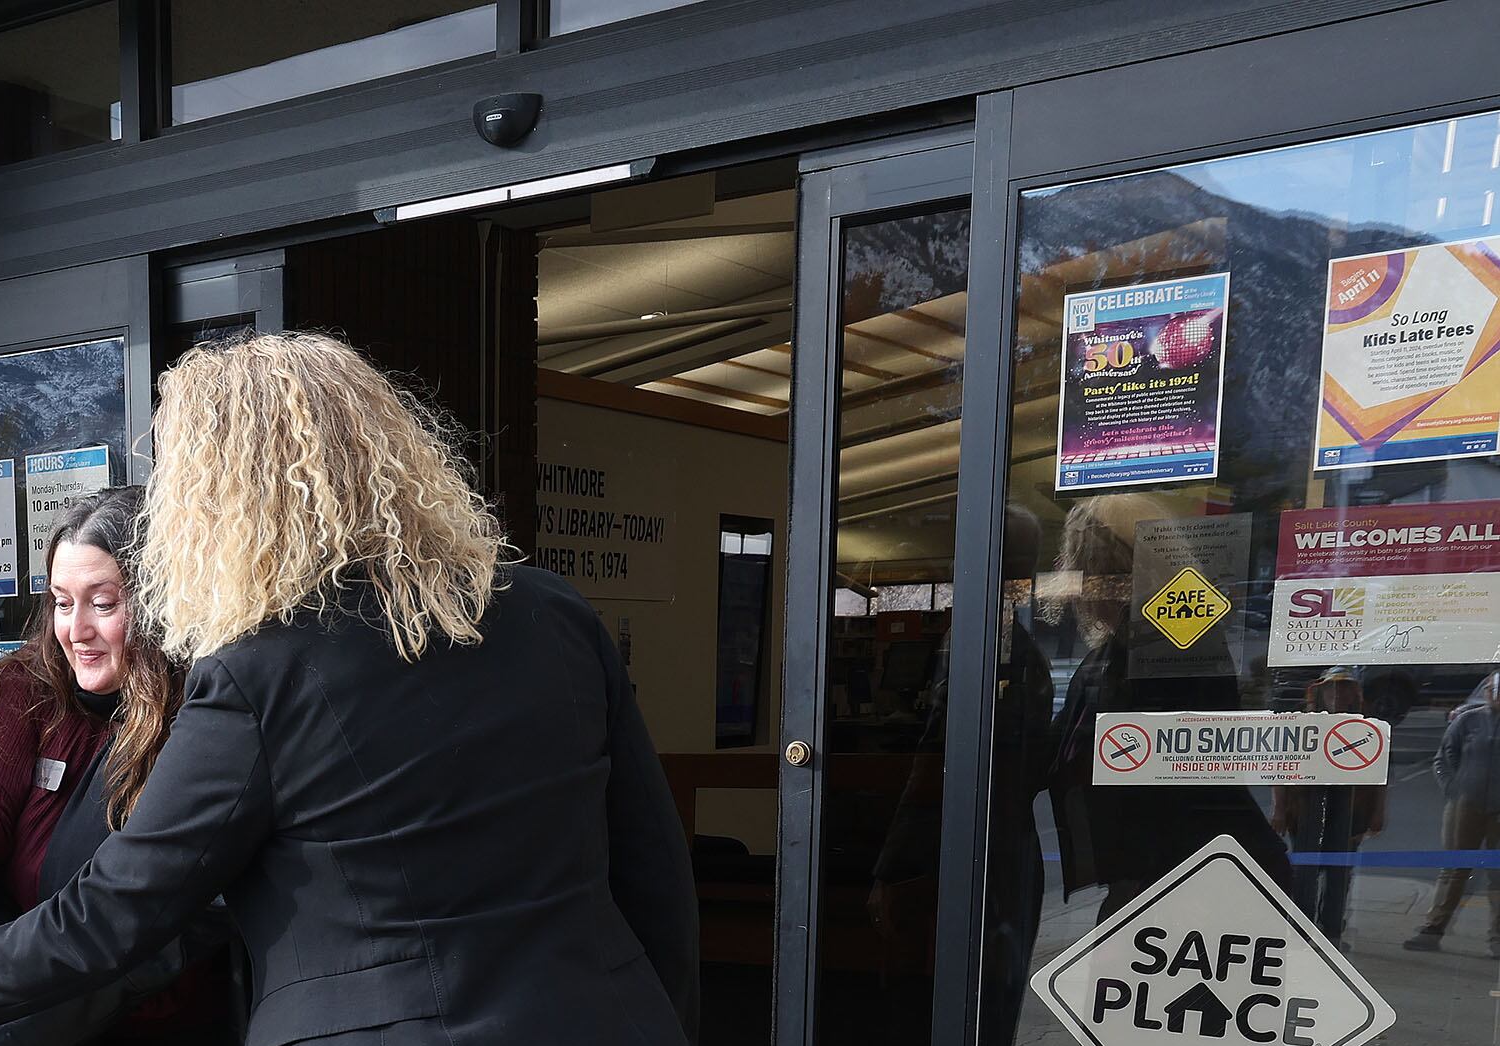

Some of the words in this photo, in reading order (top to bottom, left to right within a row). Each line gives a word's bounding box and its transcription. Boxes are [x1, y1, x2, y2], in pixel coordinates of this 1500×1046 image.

[1340, 268, 1365, 286] Begins
[1337, 277, 1370, 304] April
[1367, 269, 1381, 282] 11
[1073, 303, 1093, 315] NOV
[1097, 285, 1184, 311] CELEBRATE
[1076, 315, 1088, 327] 15
[1391, 314, 1408, 326] So
[1412, 310, 1448, 327] Long
[1084, 331, 1143, 345] Whitmore's
[1363, 334, 1396, 348] Kids
[1400, 328, 1432, 344] Late
[1437, 324, 1474, 338] Fees
[1084, 364, 1141, 380] Anniversary
[1084, 382, 1121, 396] Party
[1122, 379, 1146, 392] like
[1121, 425, 1157, 435] celebrate
[1159, 423, 1174, 431] this
[1114, 432, 1152, 444] milestone
[31, 456, 63, 472] HOURS
[32, 500, 42, 512] 10
[1294, 522, 1313, 530] Salt
[1316, 521, 1339, 529] Lake
[1342, 519, 1378, 527] County
[2, 538, 12, 548] pm
[1294, 526, 1442, 550] WELCOMES
[1447, 523, 1500, 542] ALL
[34, 539, 43, 550] 10
[4, 563, 12, 572] 29
[1296, 557, 1323, 565] inclusive
[1166, 590, 1206, 604] SAFE
[1289, 588, 1346, 618] SL
[1288, 619, 1322, 629] SALT
[1326, 619, 1363, 629] LAKE
[1286, 629, 1362, 642] COUNTY
[1286, 642, 1360, 652] DIVERSE
[1156, 728, 1191, 753] NO
[1198, 726, 1319, 753] SMOKING
[1172, 763, 1204, 771] INSIDE
[1207, 763, 1219, 771] OR
[1223, 762, 1258, 771] WITHIN
[1262, 762, 1273, 770] 25
[1277, 762, 1300, 770] FEET
[1130, 926, 1287, 987] SAFE
